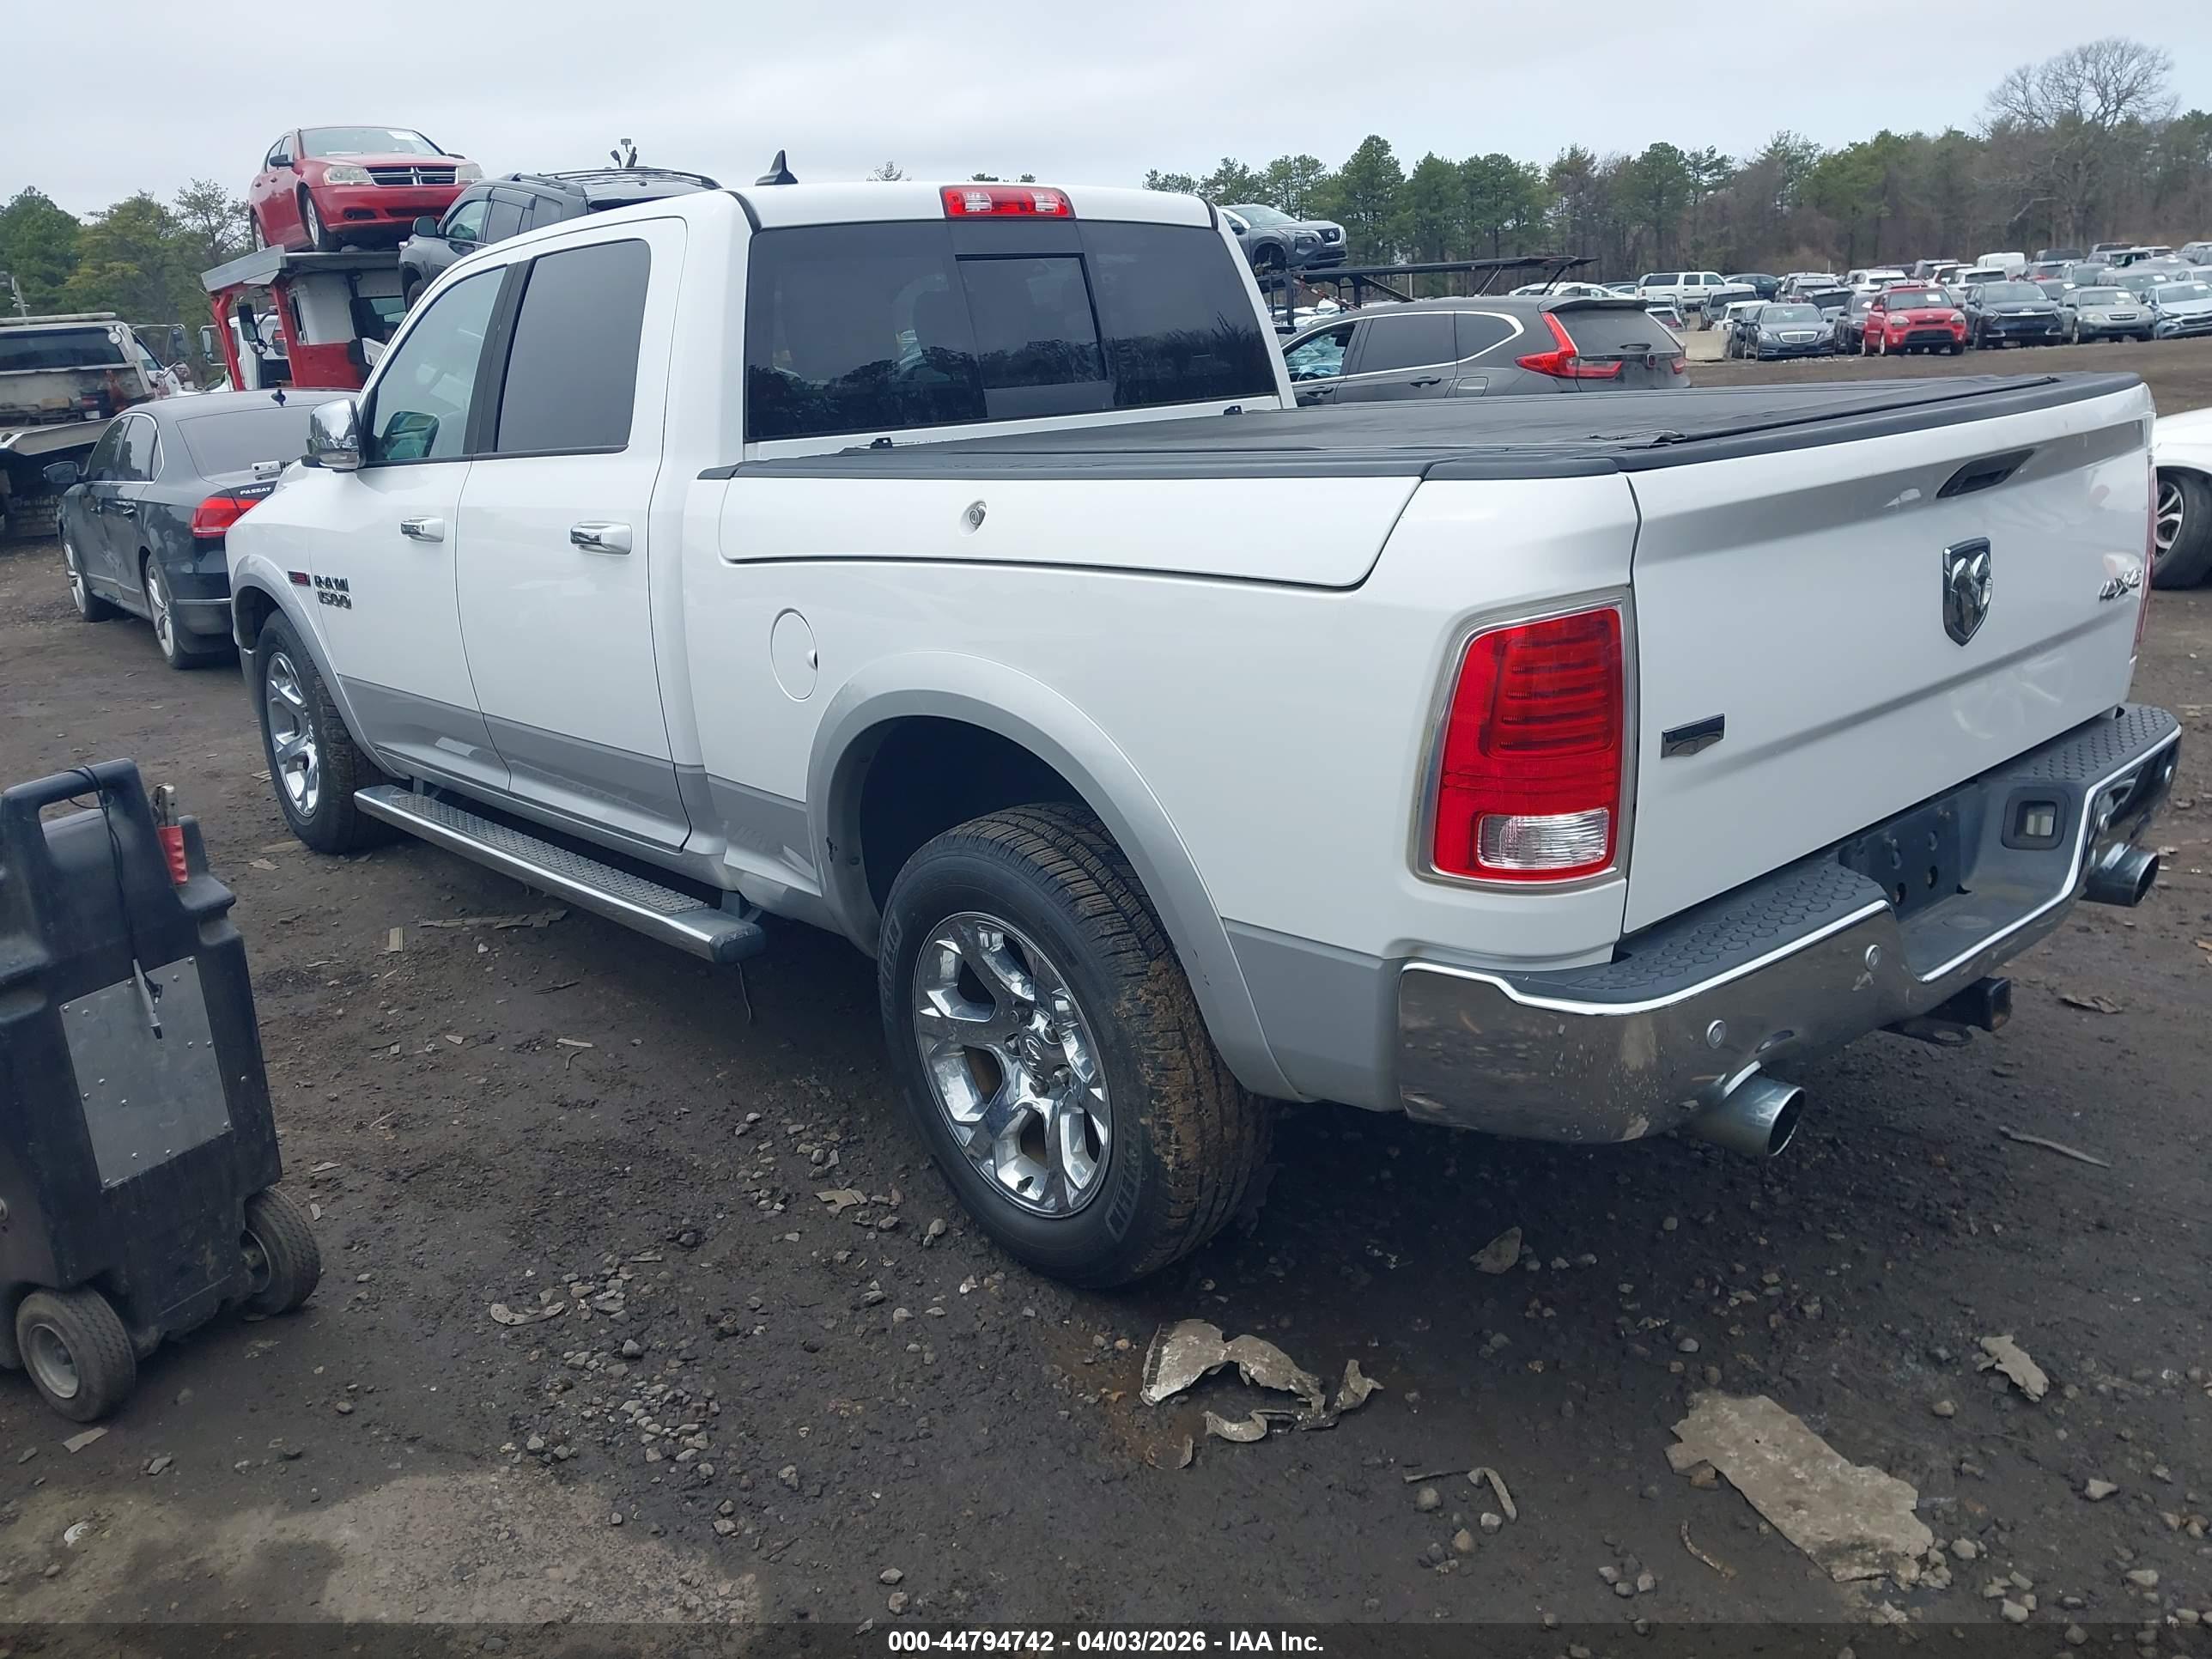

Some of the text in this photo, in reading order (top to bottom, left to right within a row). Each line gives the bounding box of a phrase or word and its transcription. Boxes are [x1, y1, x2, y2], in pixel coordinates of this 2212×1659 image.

[240, 487, 271, 495] PASSAT
[313, 574, 349, 592] RAM
[317, 590, 352, 610] 1500
